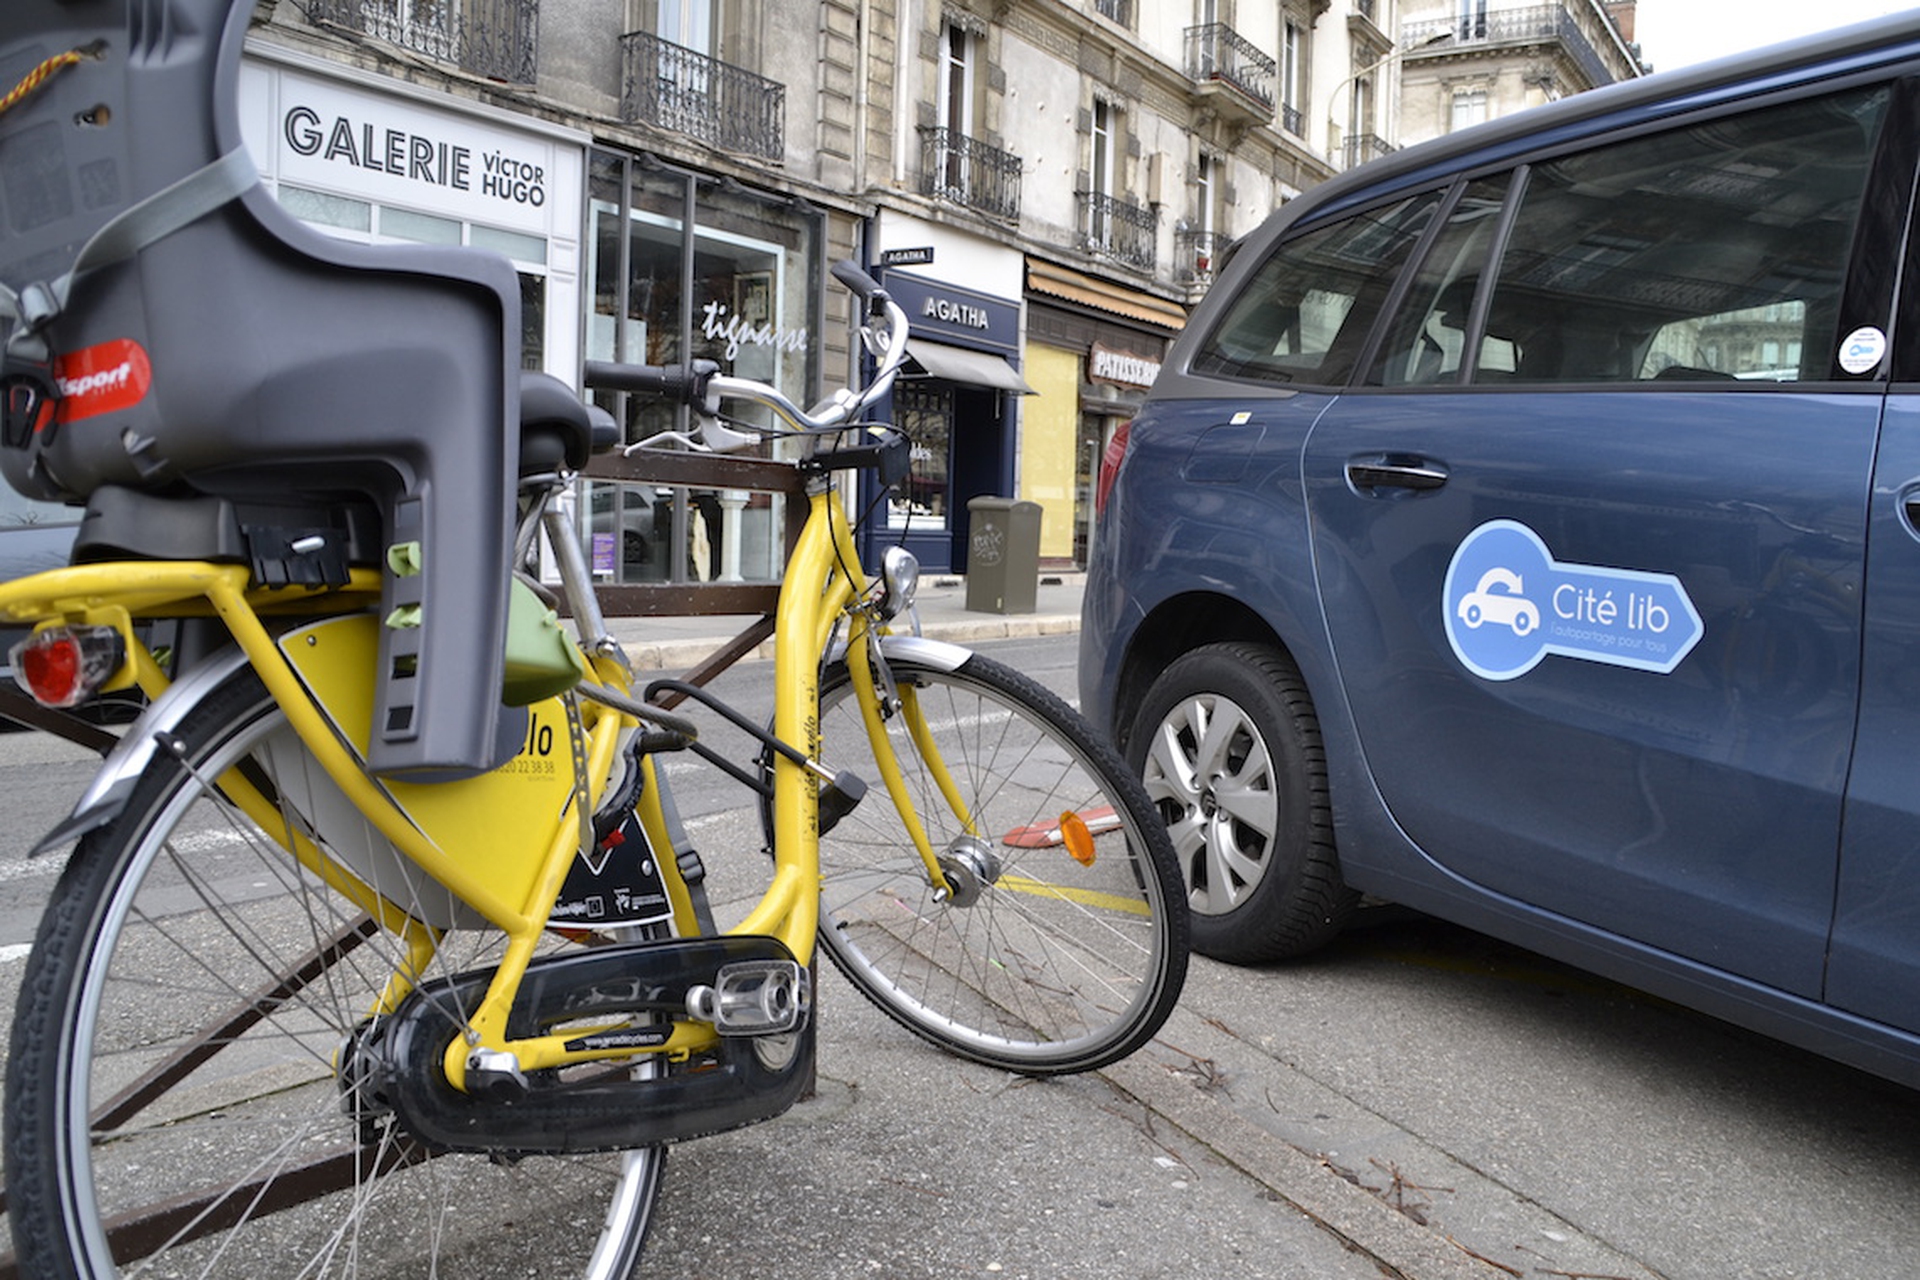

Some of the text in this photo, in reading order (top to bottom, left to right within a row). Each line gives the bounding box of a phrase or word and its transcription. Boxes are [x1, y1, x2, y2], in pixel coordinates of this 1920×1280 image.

[284, 106, 470, 191] GALERIE
[482, 173, 545, 207] HUGO
[887, 249, 926, 262] AGATHA
[701, 300, 807, 361] tignasse
[924, 296, 989, 329] AGATHA
[1552, 583, 1670, 633] Cité lib
[517, 712, 553, 756] lo
[517, 760, 530, 774] 22
[531, 760, 543, 774] 38
[543, 760, 556, 774] 38
